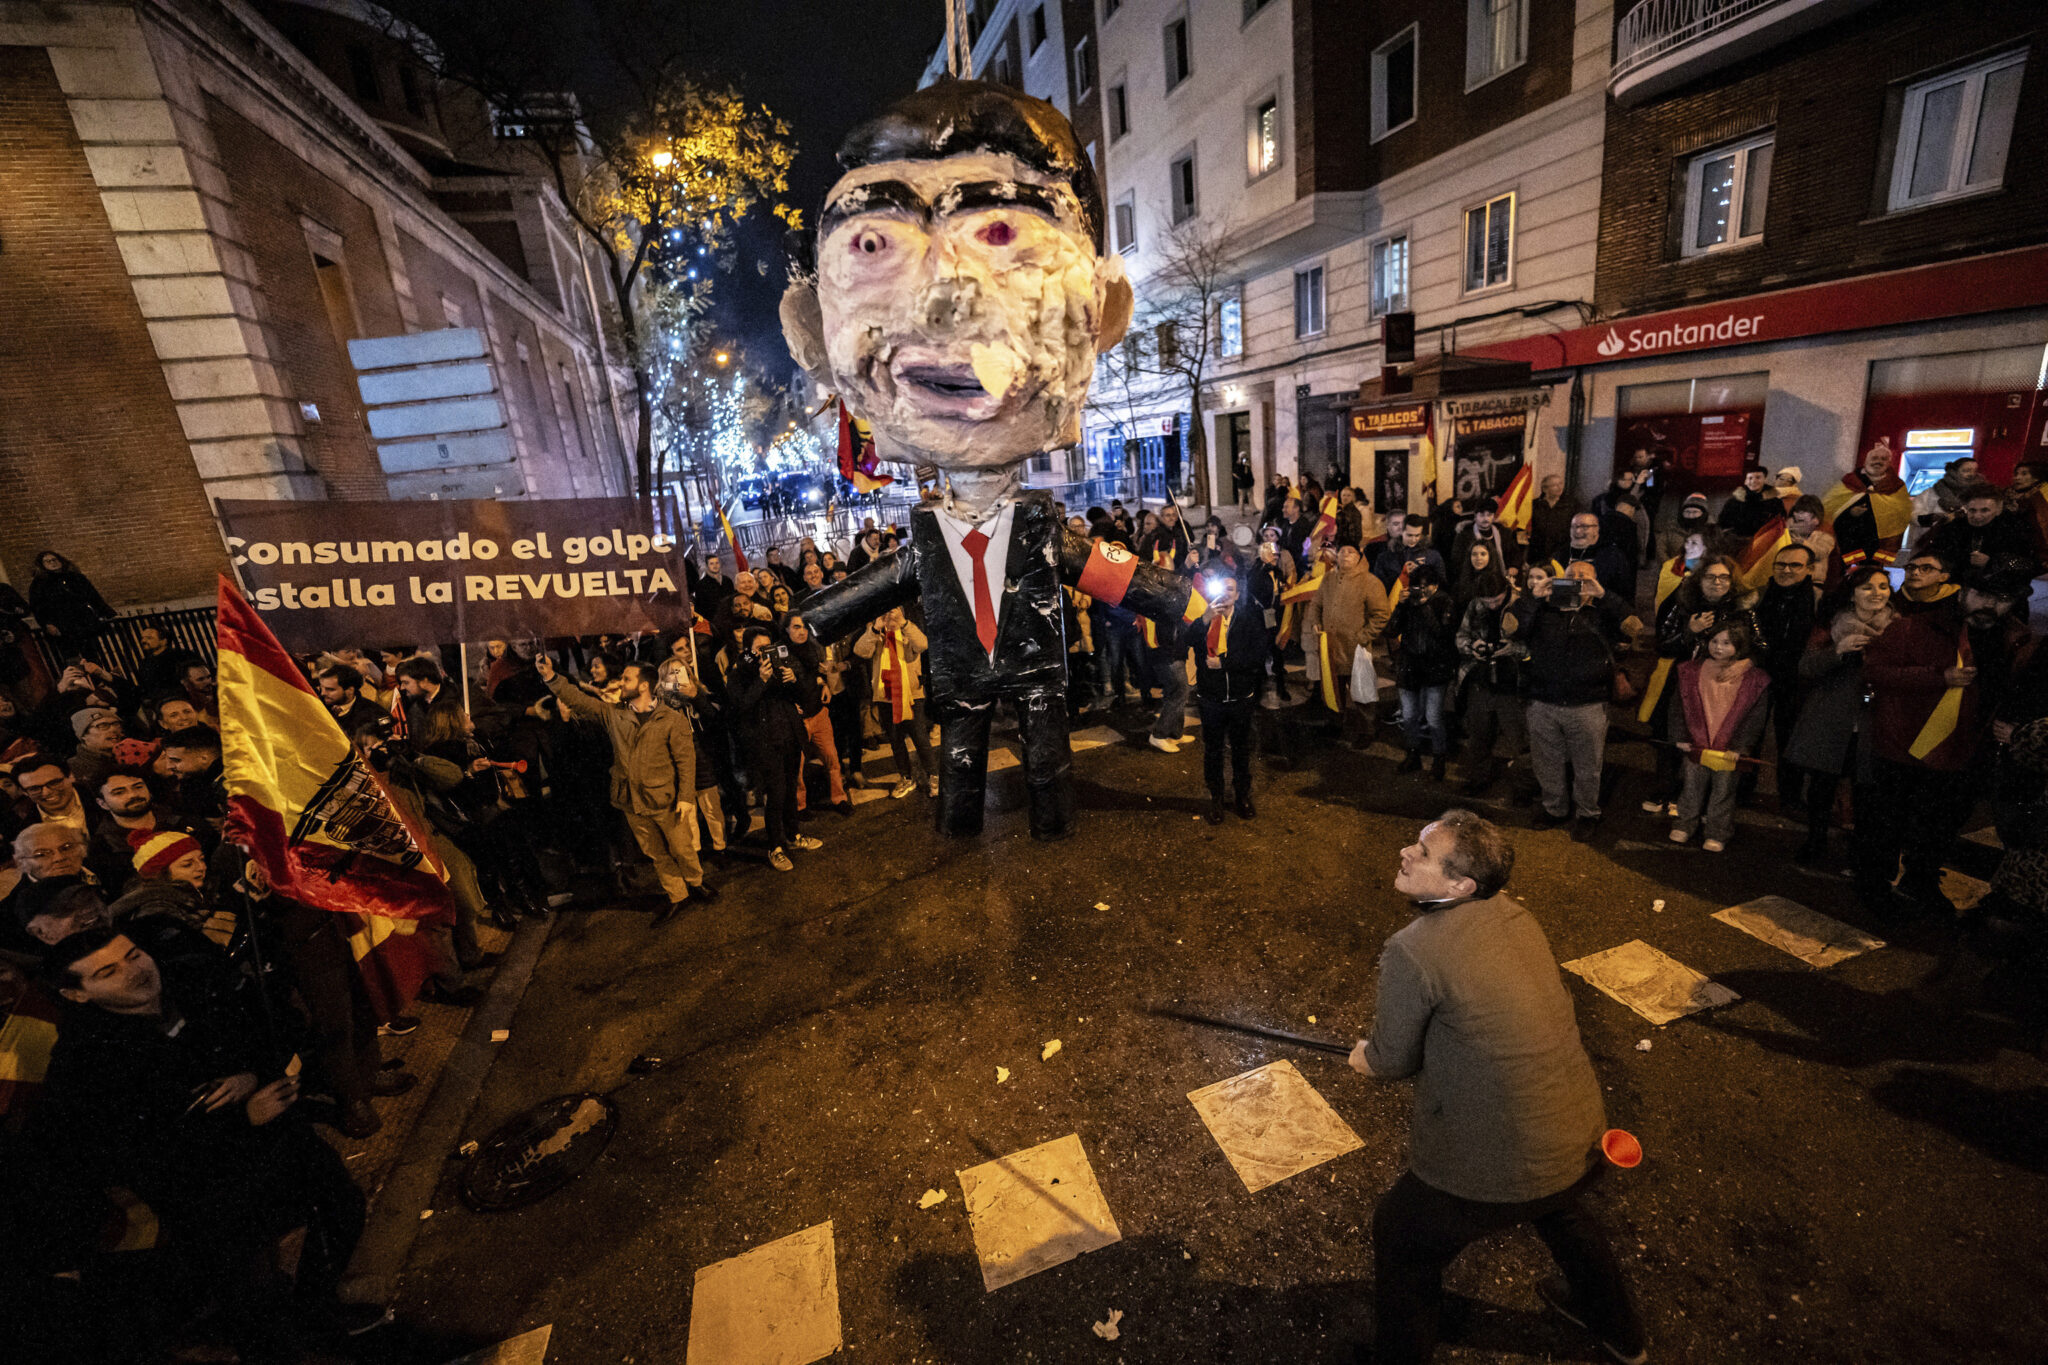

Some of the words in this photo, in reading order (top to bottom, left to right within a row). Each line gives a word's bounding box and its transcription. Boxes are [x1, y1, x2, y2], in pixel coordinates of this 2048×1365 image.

[1628, 315, 1764, 352] Santander
[1461, 396, 1528, 413] TABACALERA
[1367, 410, 1418, 426] TABACOS
[1472, 415, 1525, 431] TABACOS
[512, 532, 552, 559] el
[563, 529, 672, 564] golpe
[247, 578, 395, 611] stalla
[410, 576, 453, 604] la
[465, 568, 677, 601] REVUELTA
